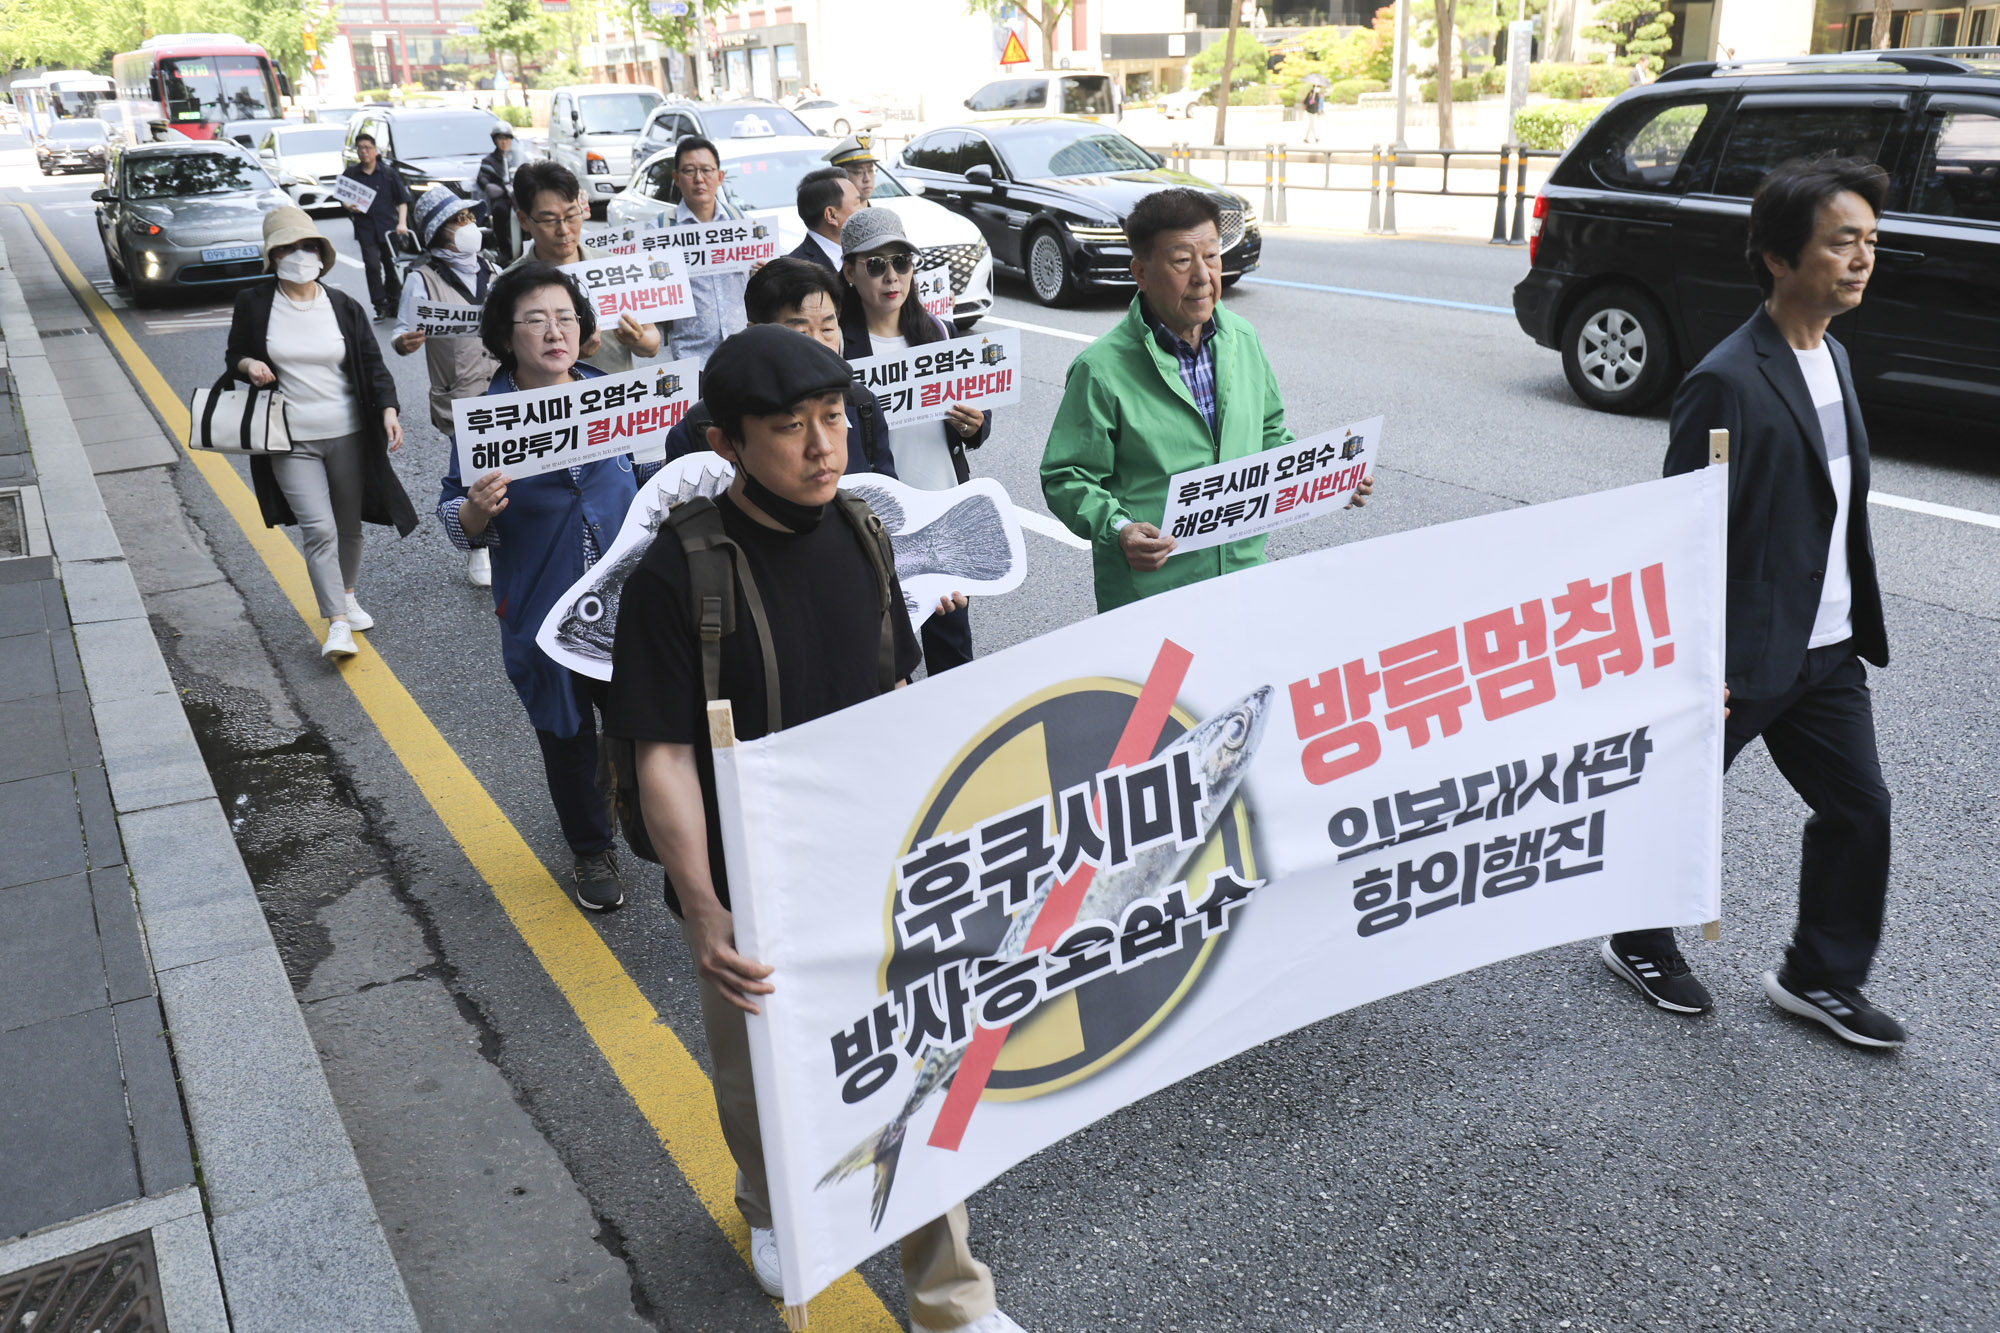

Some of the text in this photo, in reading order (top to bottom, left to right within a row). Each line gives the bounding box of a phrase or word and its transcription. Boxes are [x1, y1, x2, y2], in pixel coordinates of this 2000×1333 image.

[585, 233, 619, 248] 오염수
[642, 232, 700, 252] 후쿠시마
[705, 227, 748, 246] 오염수
[711, 242, 774, 264] 결사반대!
[585, 264, 644, 290] 오염수
[598, 284, 684, 316] 결사반대!
[416, 306, 481, 322] 후쿠시마
[914, 348, 975, 378] 오염수
[466, 380, 648, 434] 후쿠시마 오염수
[920, 368, 1012, 408] 결사반대!
[472, 400, 690, 470] 해양투기 결사반대!
[1177, 443, 1336, 507] 후쿠시마 오염수
[1171, 462, 1367, 539] 해양투기 결사반대!
[1288, 562, 1675, 786] 방류멈춰!
[902, 751, 1203, 945] 후쿠시마
[1352, 809, 1607, 938] 항의행진
[831, 874, 1256, 1105] 방사능오염수
